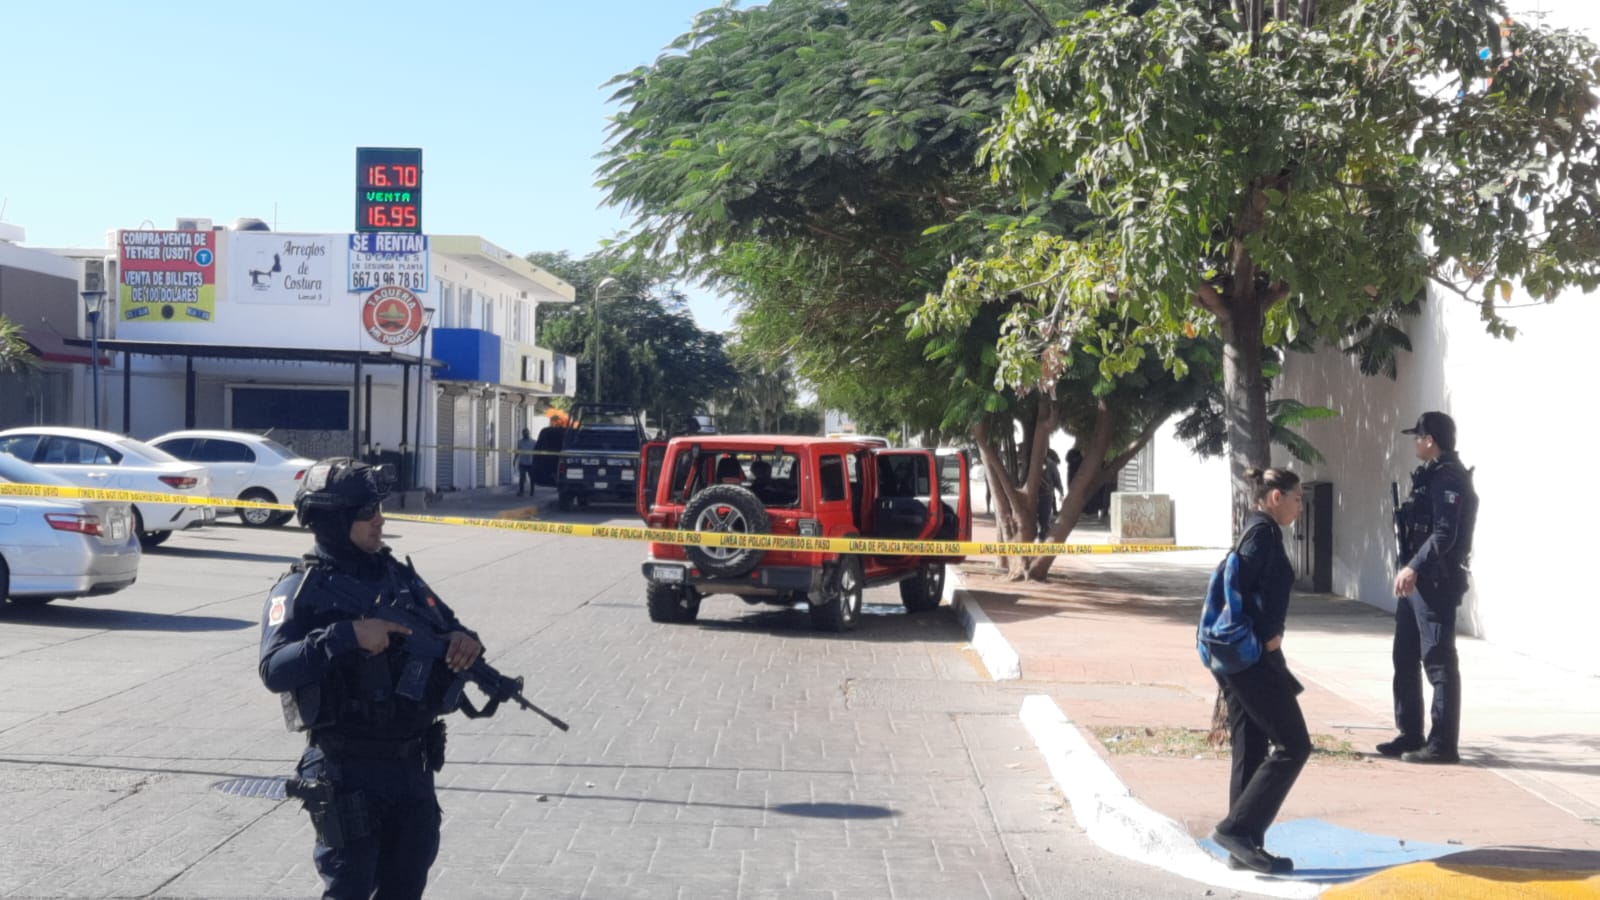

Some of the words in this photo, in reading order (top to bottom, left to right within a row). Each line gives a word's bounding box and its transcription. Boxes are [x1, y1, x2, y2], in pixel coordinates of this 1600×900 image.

[368, 165, 417, 187] 16.70
[366, 191, 411, 202] VENTA
[368, 205, 417, 227] 16.95
[122, 231, 192, 246] COMPRA-VENTA
[194, 232, 207, 246] DE
[352, 235, 369, 251] SE
[375, 235, 425, 252] RENTAN
[124, 246, 160, 259] TETHER
[162, 246, 193, 262] (USDT)
[283, 240, 326, 260] Arreglos
[356, 253, 420, 261] LOCALES
[297, 261, 310, 276] de
[124, 271, 151, 286] VENTA
[152, 271, 164, 286] DE
[165, 271, 204, 286] BILLETES
[284, 274, 322, 290] Costura
[353, 271, 370, 288] 667
[373, 272, 380, 288] 9
[398, 272, 410, 288] 78
[413, 272, 425, 288] 61
[132, 287, 143, 302] DE
[144, 287, 160, 302] 100
[161, 287, 198, 302] DOLARES
[592, 527, 609, 537] LINEA
[610, 528, 618, 538] DE
[620, 528, 643, 539] POLICIA
[644, 529, 676, 541] PROHIBIDO
[677, 532, 684, 542] EL
[686, 532, 702, 543] PASO
[720, 535, 737, 545] LINEA
[738, 536, 746, 546] DE
[748, 536, 771, 547] POLICIA
[772, 537, 805, 548] PROHIBIDO
[805, 538, 813, 549] EL
[815, 539, 830, 550] PASO
[849, 541, 866, 552] LINEA
[868, 541, 876, 552] DE
[877, 541, 900, 552] POLICIA
[902, 542, 935, 553] PROHIBIDO
[936, 543, 943, 553] EL
[945, 543, 960, 553] PASO
[979, 543, 997, 553] LINEA
[1008, 543, 1031, 553] POLICIA
[1076, 544, 1092, 553] PASO
